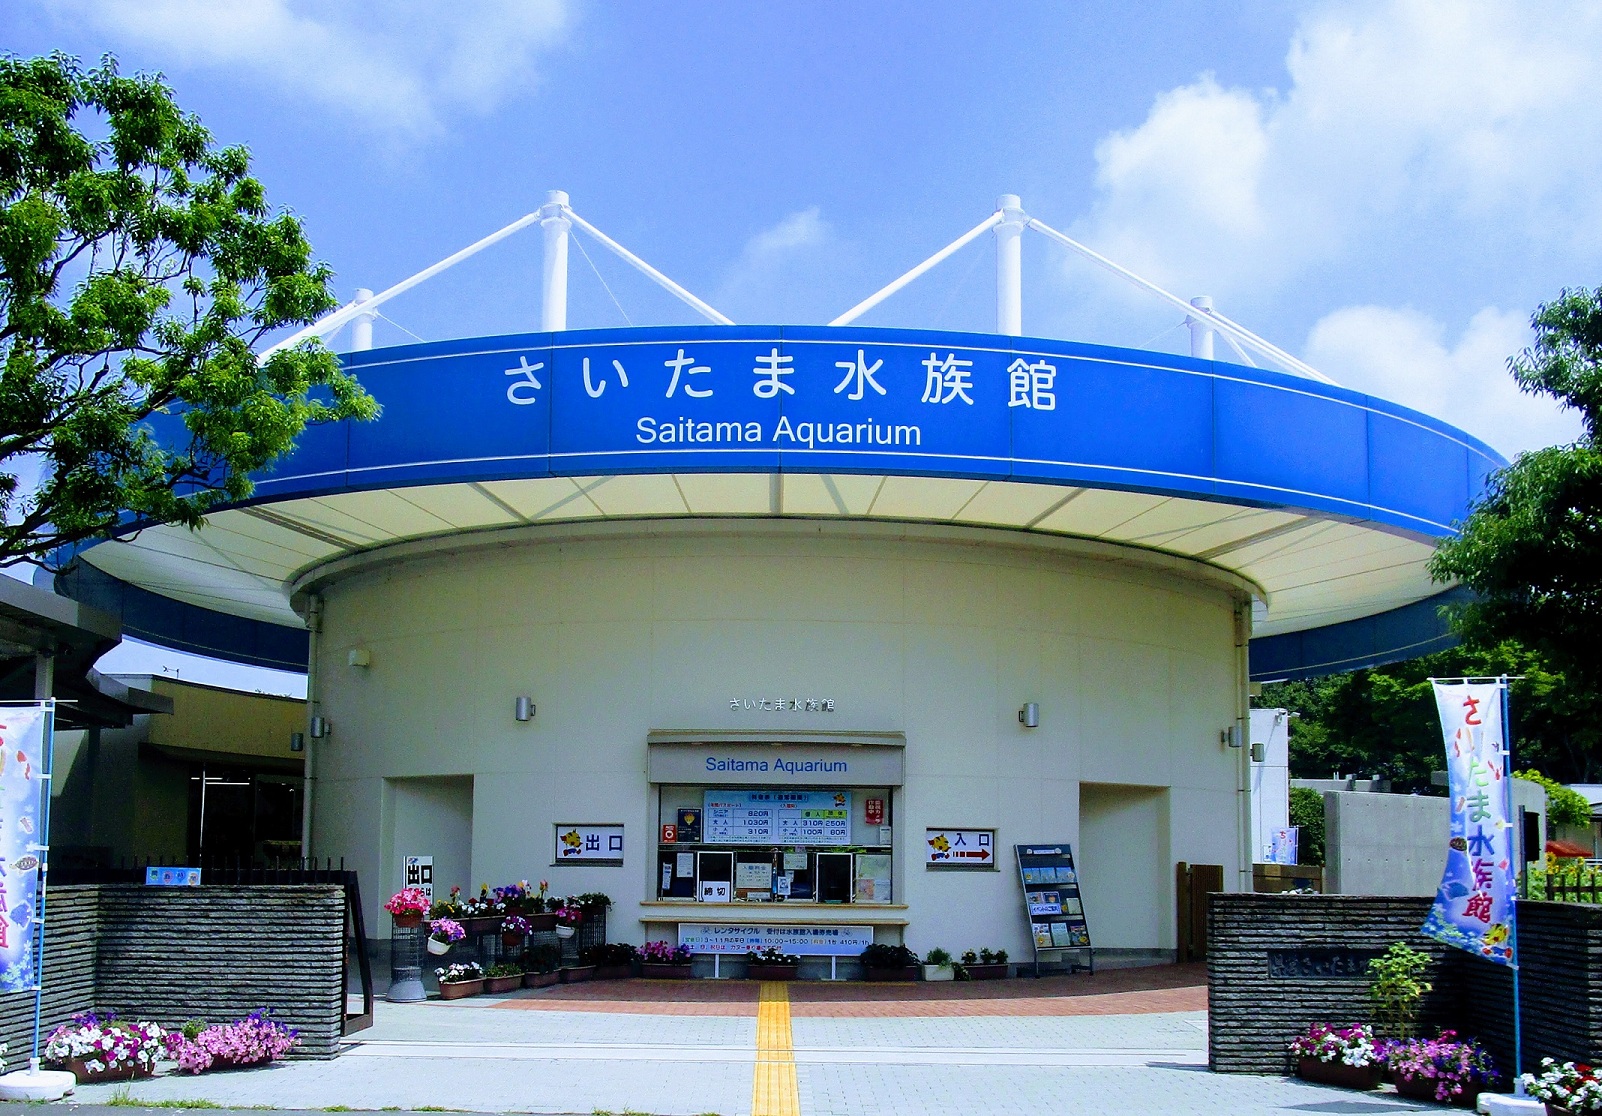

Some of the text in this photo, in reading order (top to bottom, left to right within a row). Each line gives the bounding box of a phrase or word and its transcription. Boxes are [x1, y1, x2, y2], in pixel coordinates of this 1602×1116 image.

[504, 348, 1057, 411] さいたま水族館
[635, 416, 921, 449] Saitama Aquarium
[729, 697, 835, 713] さいたま水族館
[705, 757, 847, 775] Saitama Aquarium
[585, 833, 623, 852] 出口
[954, 832, 990, 847] 入口
[407, 864, 433, 885] 出口
[714, 927, 760, 935] レンタサイクル
